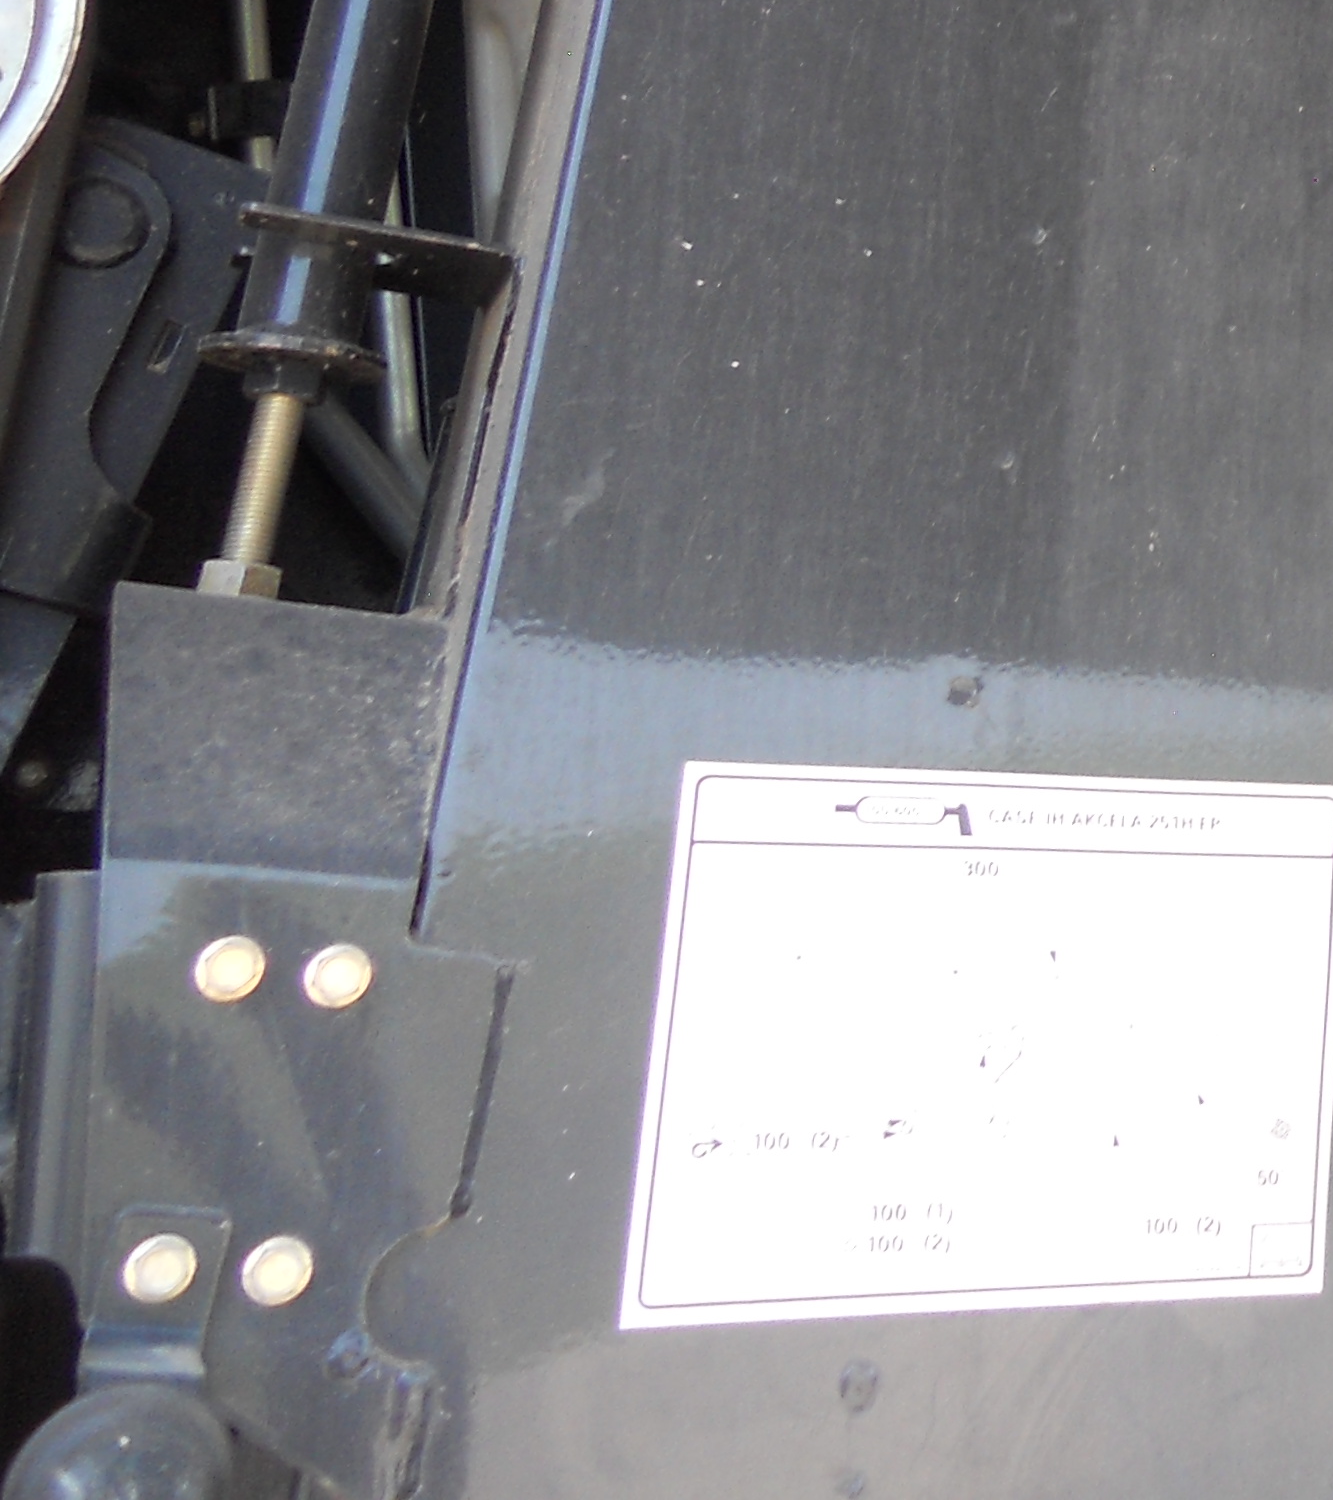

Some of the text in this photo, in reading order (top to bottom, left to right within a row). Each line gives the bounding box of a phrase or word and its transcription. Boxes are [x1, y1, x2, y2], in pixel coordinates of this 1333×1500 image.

[963, 860, 999, 877] 300
[754, 1132, 791, 1150] 100
[872, 1203, 907, 1222] 100
[1145, 1217, 1178, 1235] 100
[868, 1234, 904, 1253] 100
